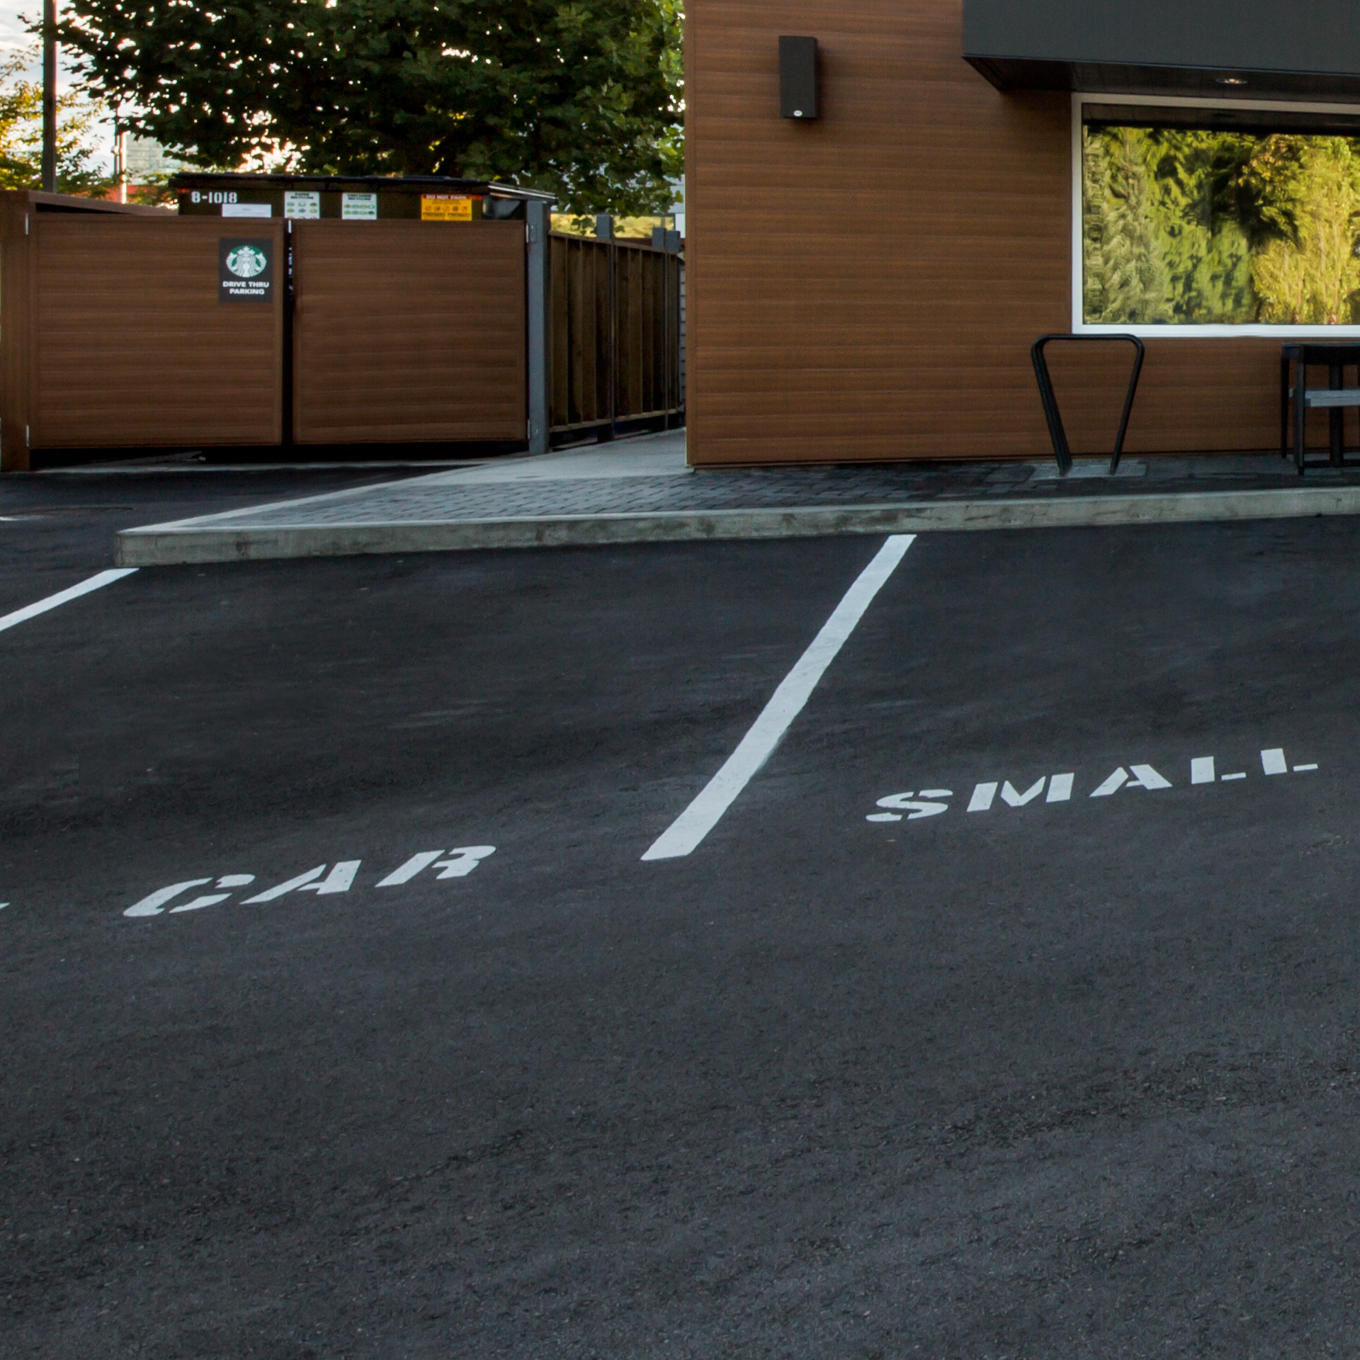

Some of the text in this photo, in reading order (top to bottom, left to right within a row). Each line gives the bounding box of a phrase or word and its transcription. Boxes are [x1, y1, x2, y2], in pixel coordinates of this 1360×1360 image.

[191, 191, 238, 204] 8-1018
[866, 748, 1318, 822] SMALL
[123, 845, 497, 917] CAR
